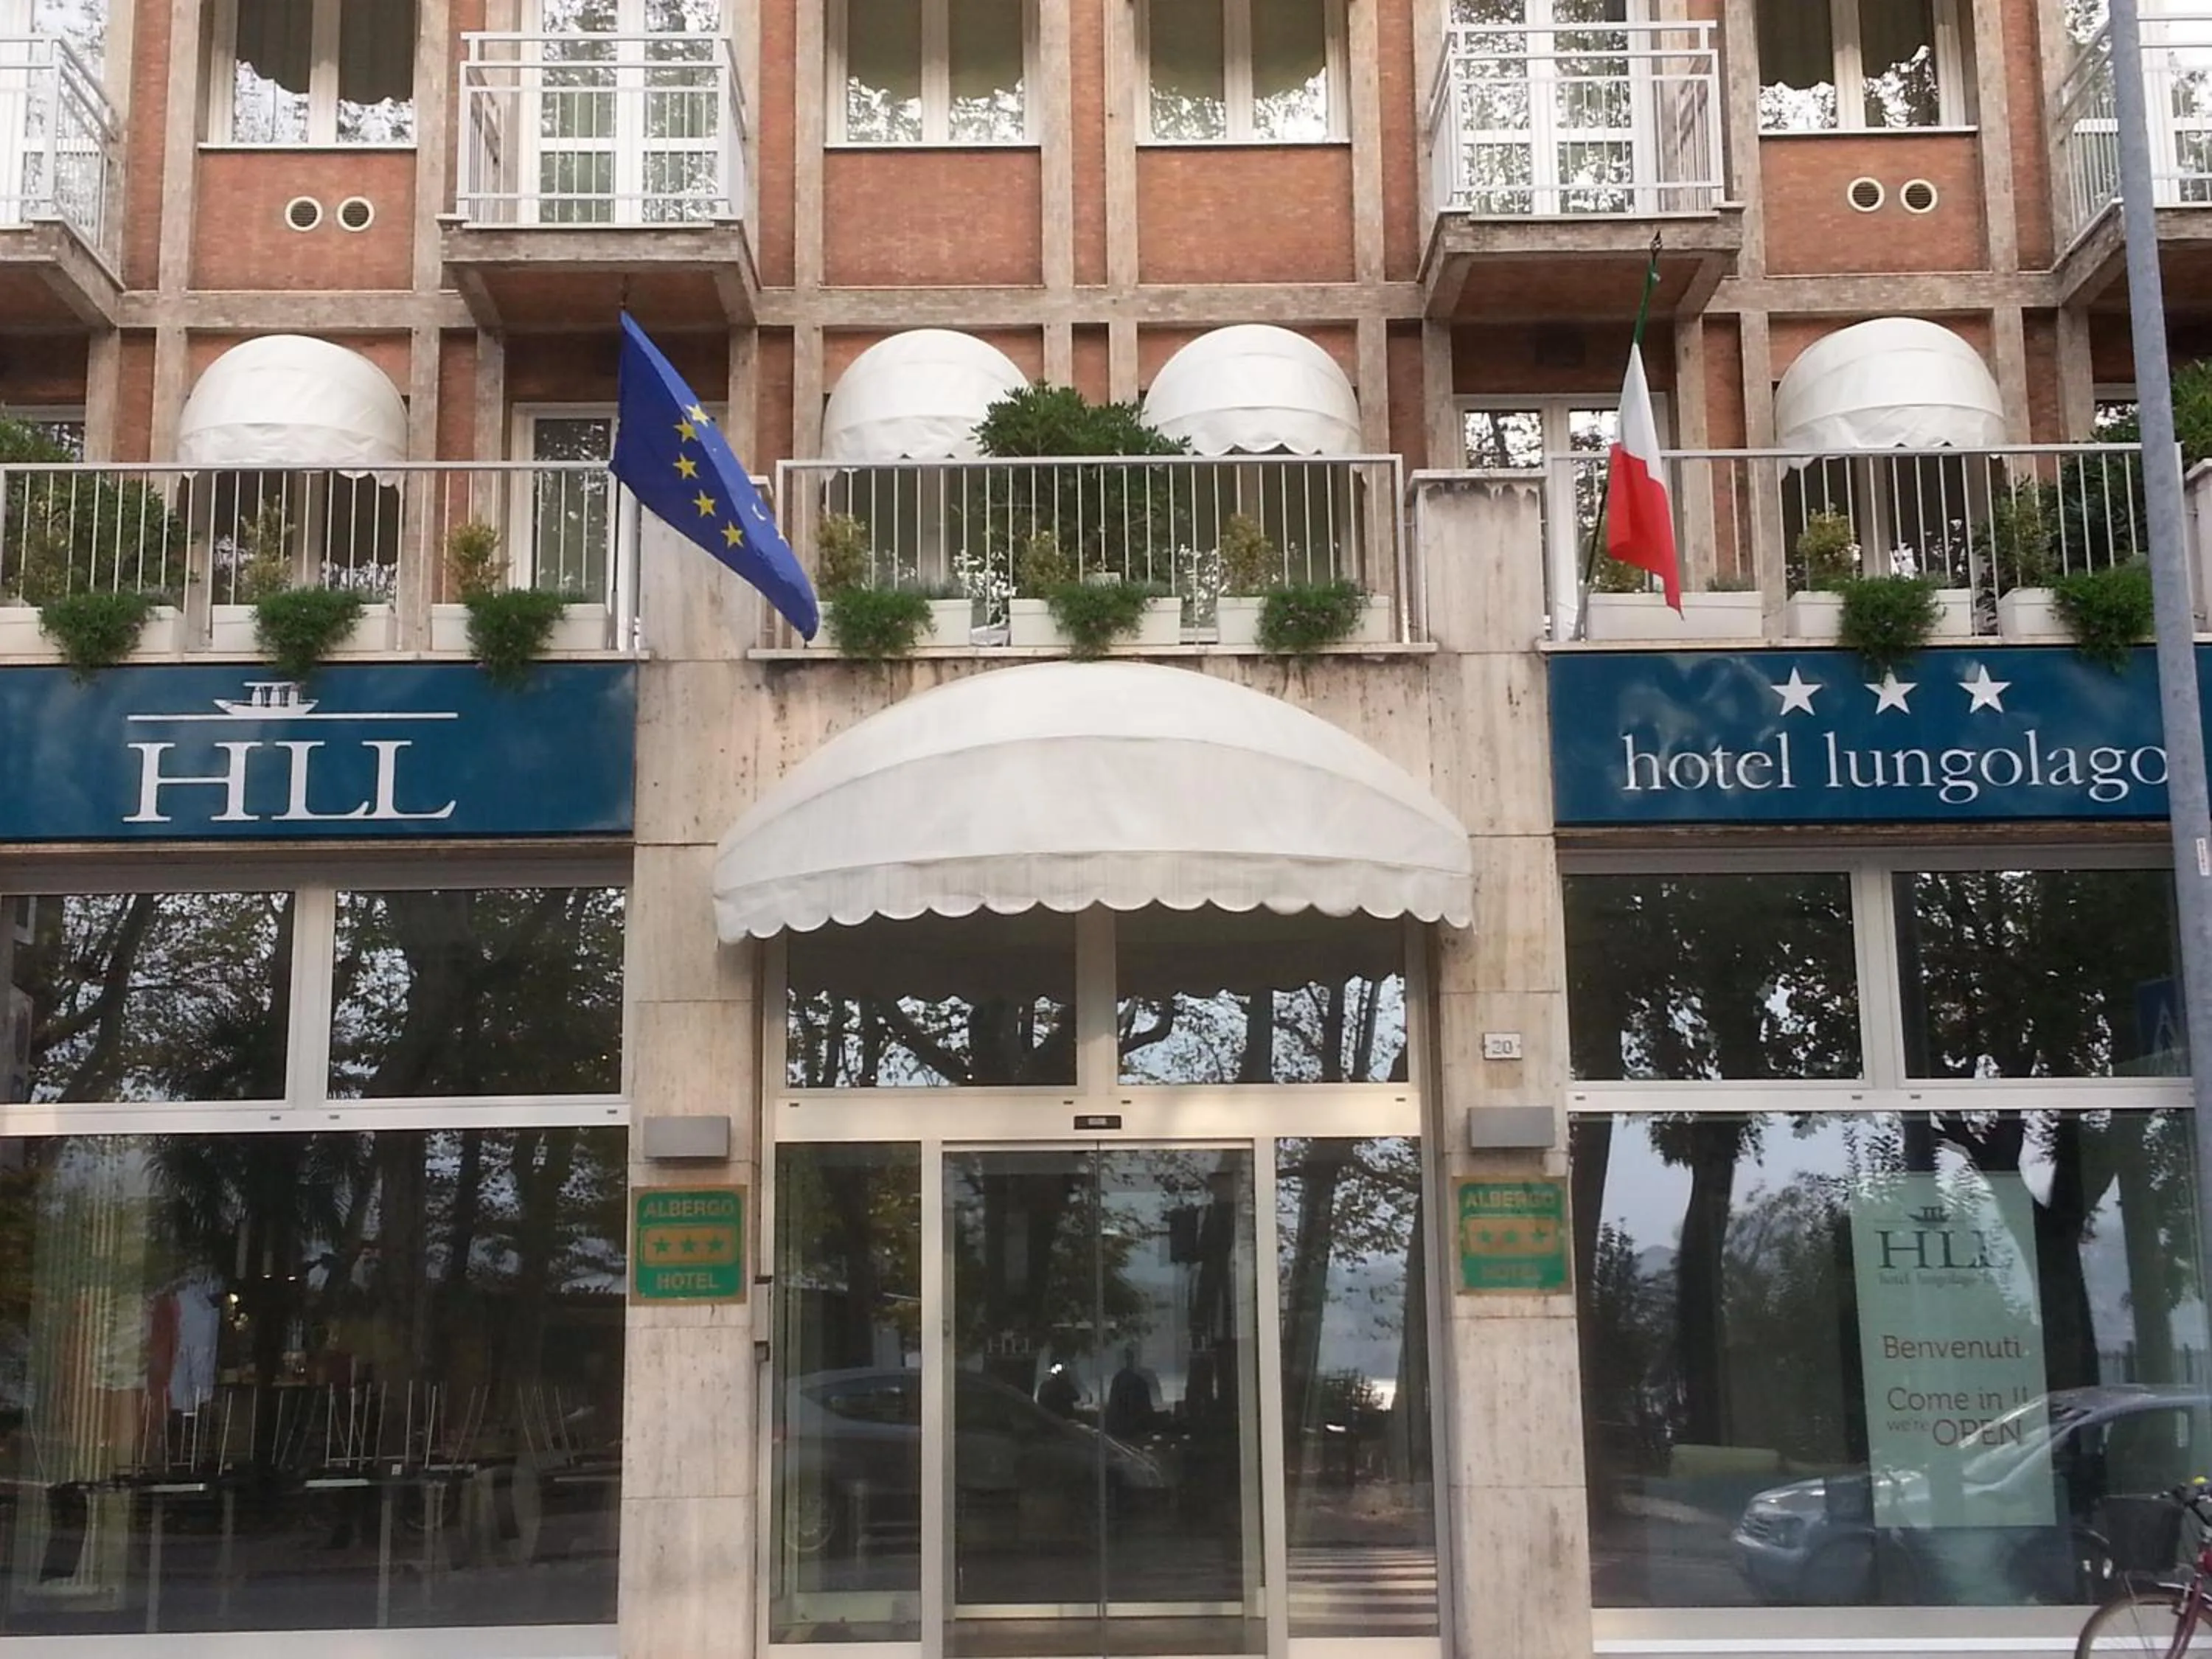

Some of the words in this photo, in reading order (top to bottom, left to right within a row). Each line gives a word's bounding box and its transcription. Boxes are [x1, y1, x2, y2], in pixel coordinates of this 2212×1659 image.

[1621, 731, 1796, 791] hotel
[1823, 729, 2168, 804] lungolago
[122, 740, 456, 823] HLL
[1491, 1040, 1513, 1054] 20
[644, 1199, 734, 1217] ALBERGO
[656, 1273, 719, 1290] HOTEL
[1883, 1335, 2022, 1358] Benvenuti
[1888, 1387, 1969, 1411] Come
[1979, 1386, 2002, 1410] in
[1933, 1419, 2022, 1445] OPEN
